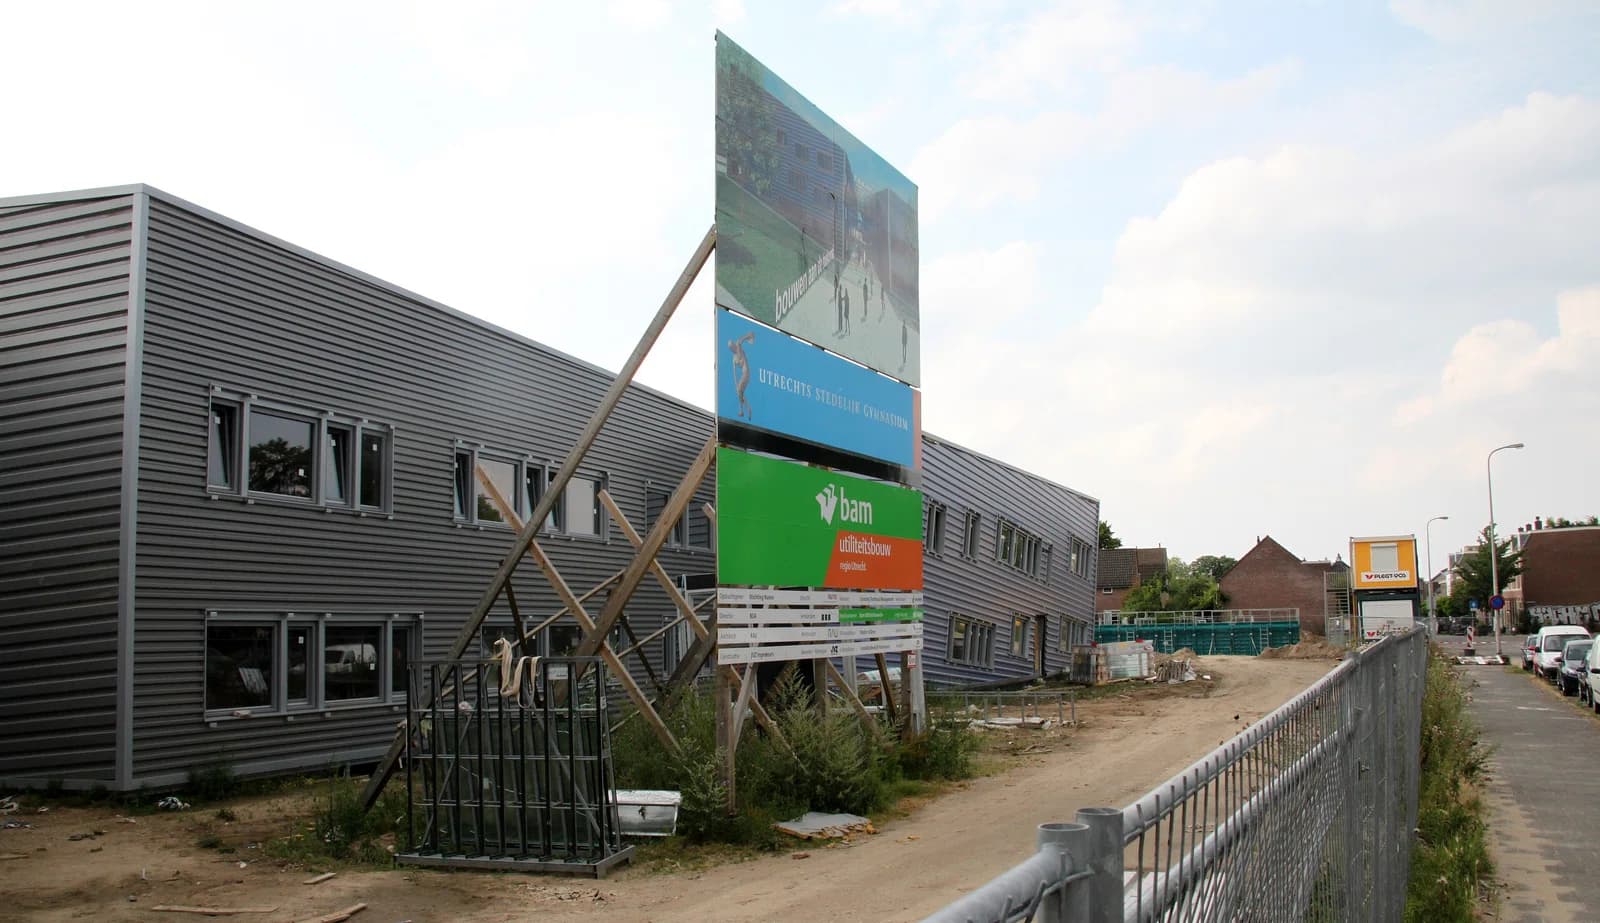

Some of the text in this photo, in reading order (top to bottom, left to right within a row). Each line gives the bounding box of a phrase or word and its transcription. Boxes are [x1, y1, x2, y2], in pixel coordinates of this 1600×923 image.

[775, 271, 808, 323] bouwen
[759, 368, 909, 431] UTRECHTS STEDELIJK GYMNASIUM
[840, 486, 873, 525] bam
[839, 534, 892, 557] utiliteitsbouw
